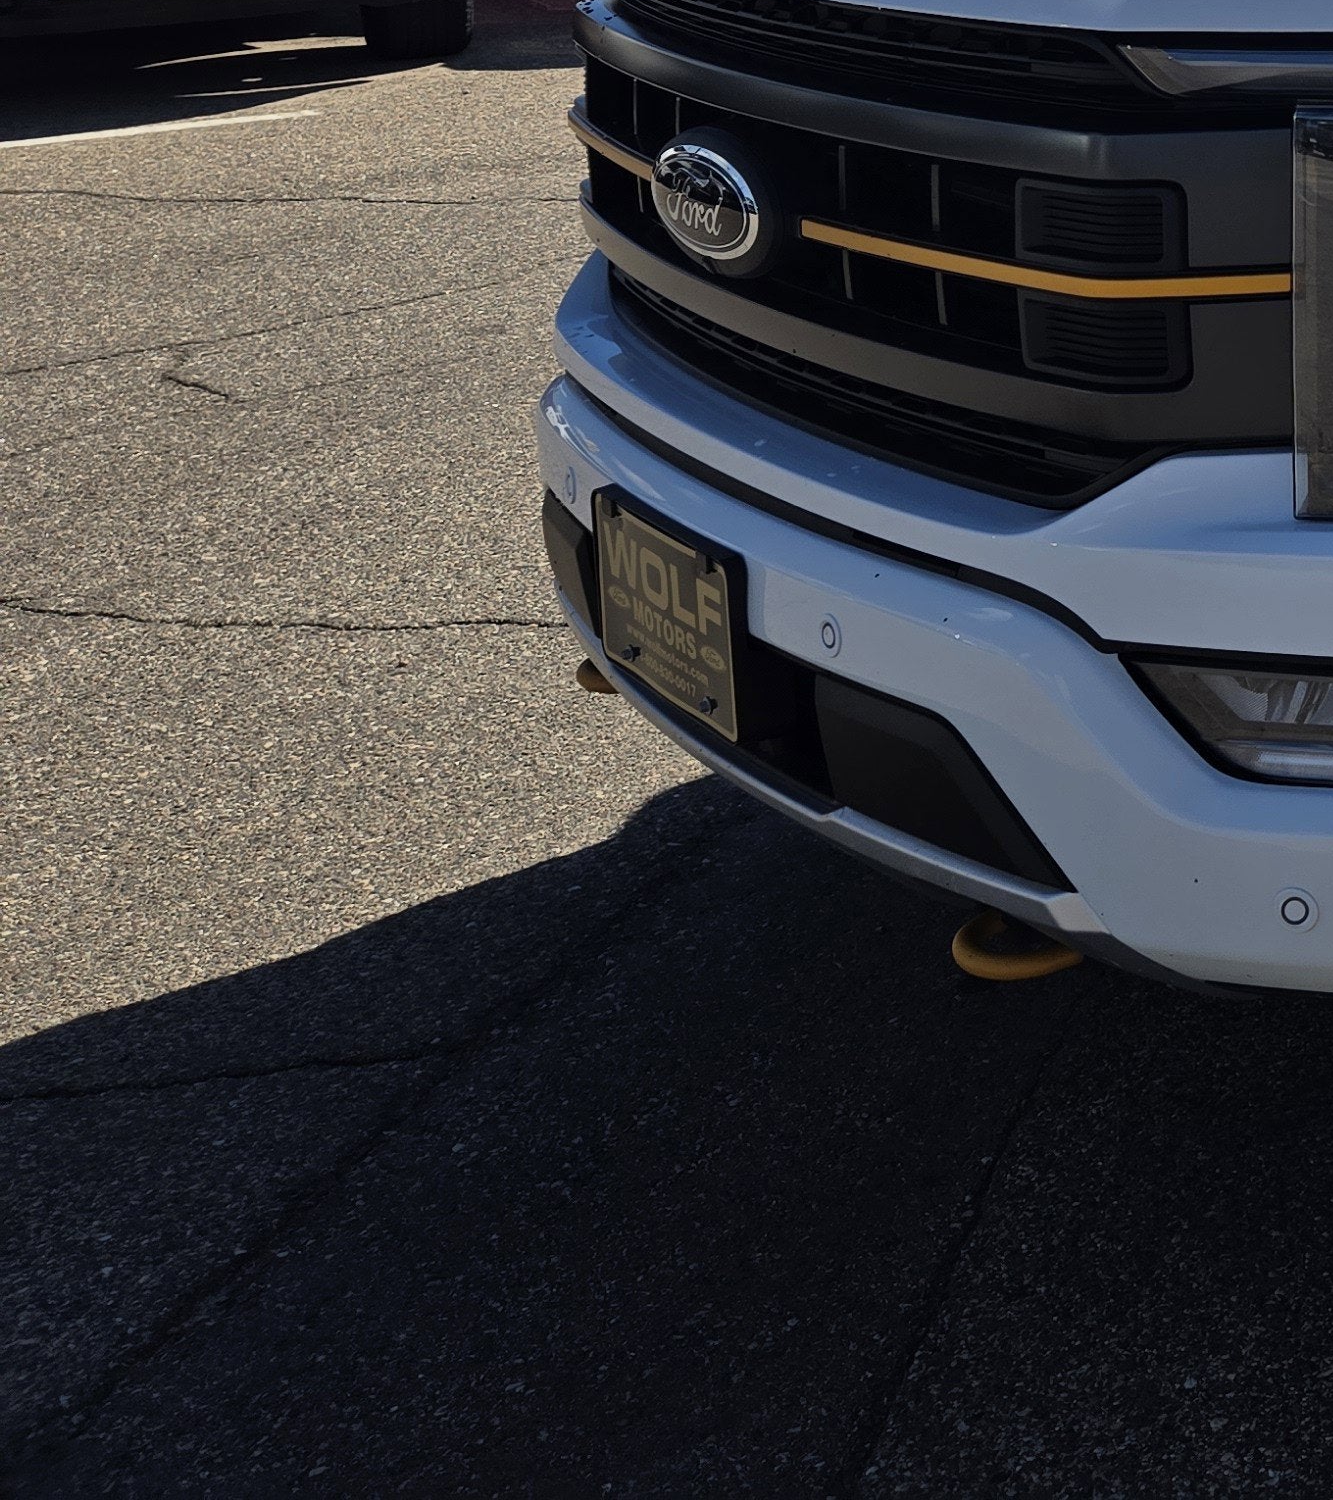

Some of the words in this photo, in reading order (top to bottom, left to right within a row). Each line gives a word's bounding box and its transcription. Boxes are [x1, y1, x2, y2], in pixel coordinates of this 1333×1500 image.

[665, 166, 724, 237] Ford
[603, 520, 722, 636] WOLF
[632, 595, 698, 661] MOTORS
